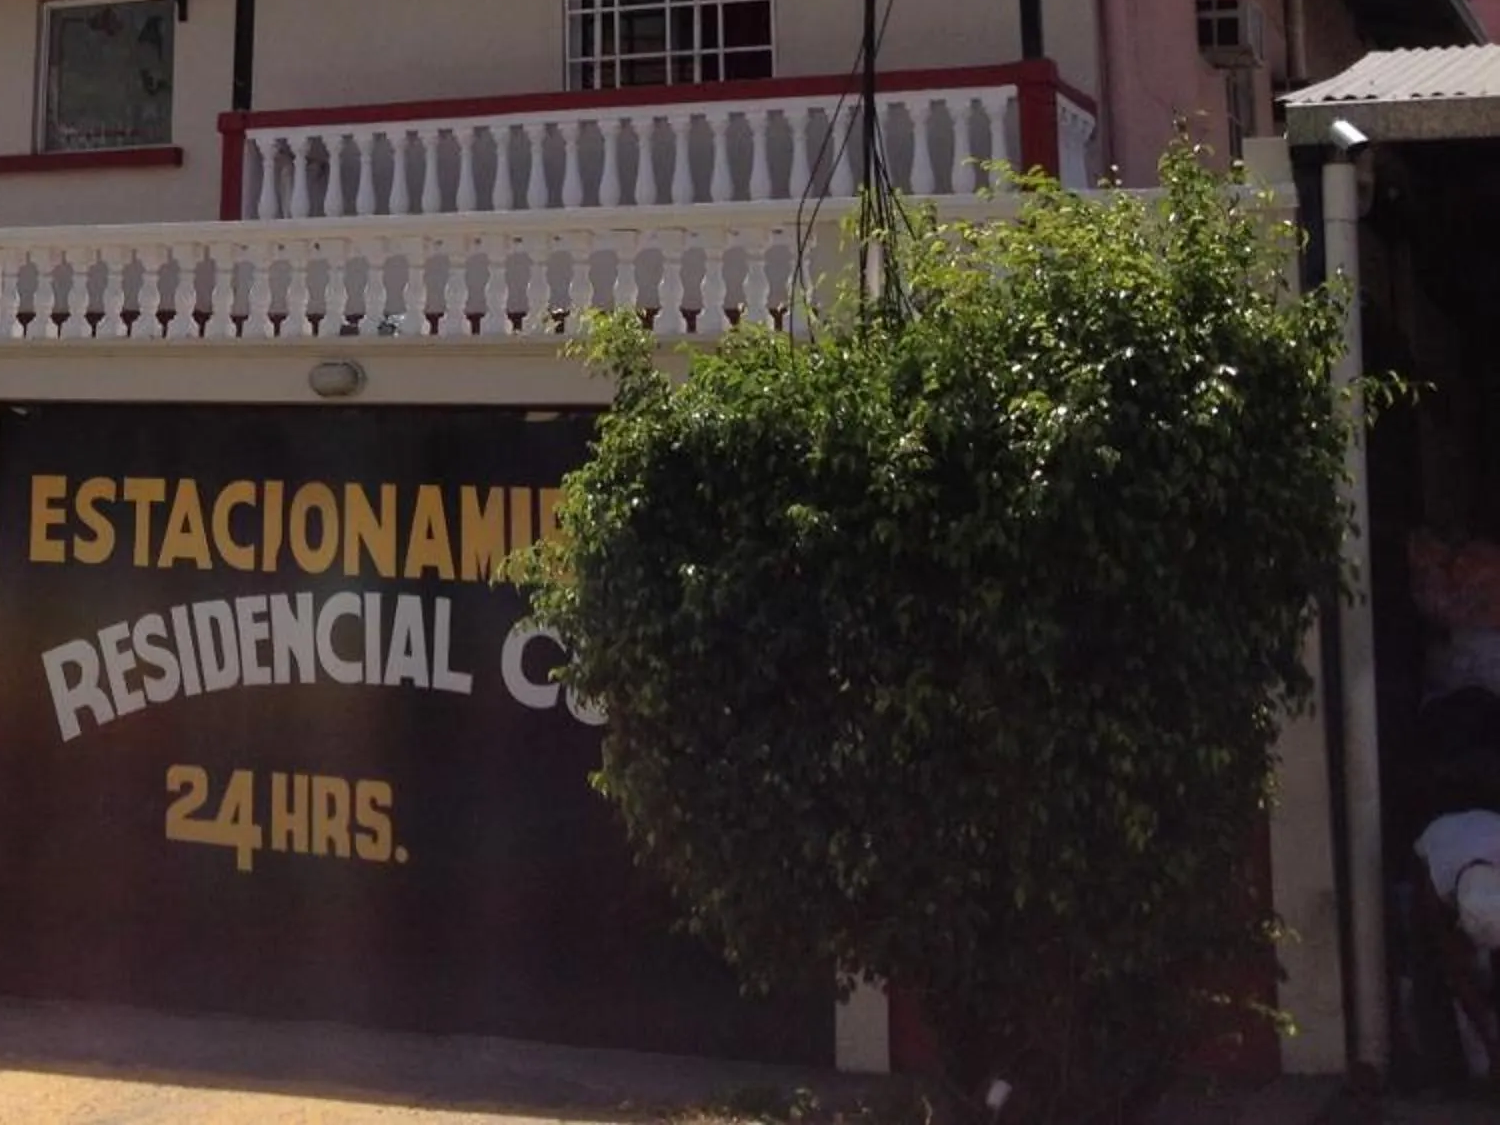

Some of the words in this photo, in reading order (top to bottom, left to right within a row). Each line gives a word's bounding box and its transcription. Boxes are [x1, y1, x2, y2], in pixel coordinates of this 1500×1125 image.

[30, 475, 577, 584] ESTACIONAMI
[41, 591, 473, 743] RESIDENCIAL
[165, 764, 262, 872] 24
[271, 772, 409, 865] HRS.
